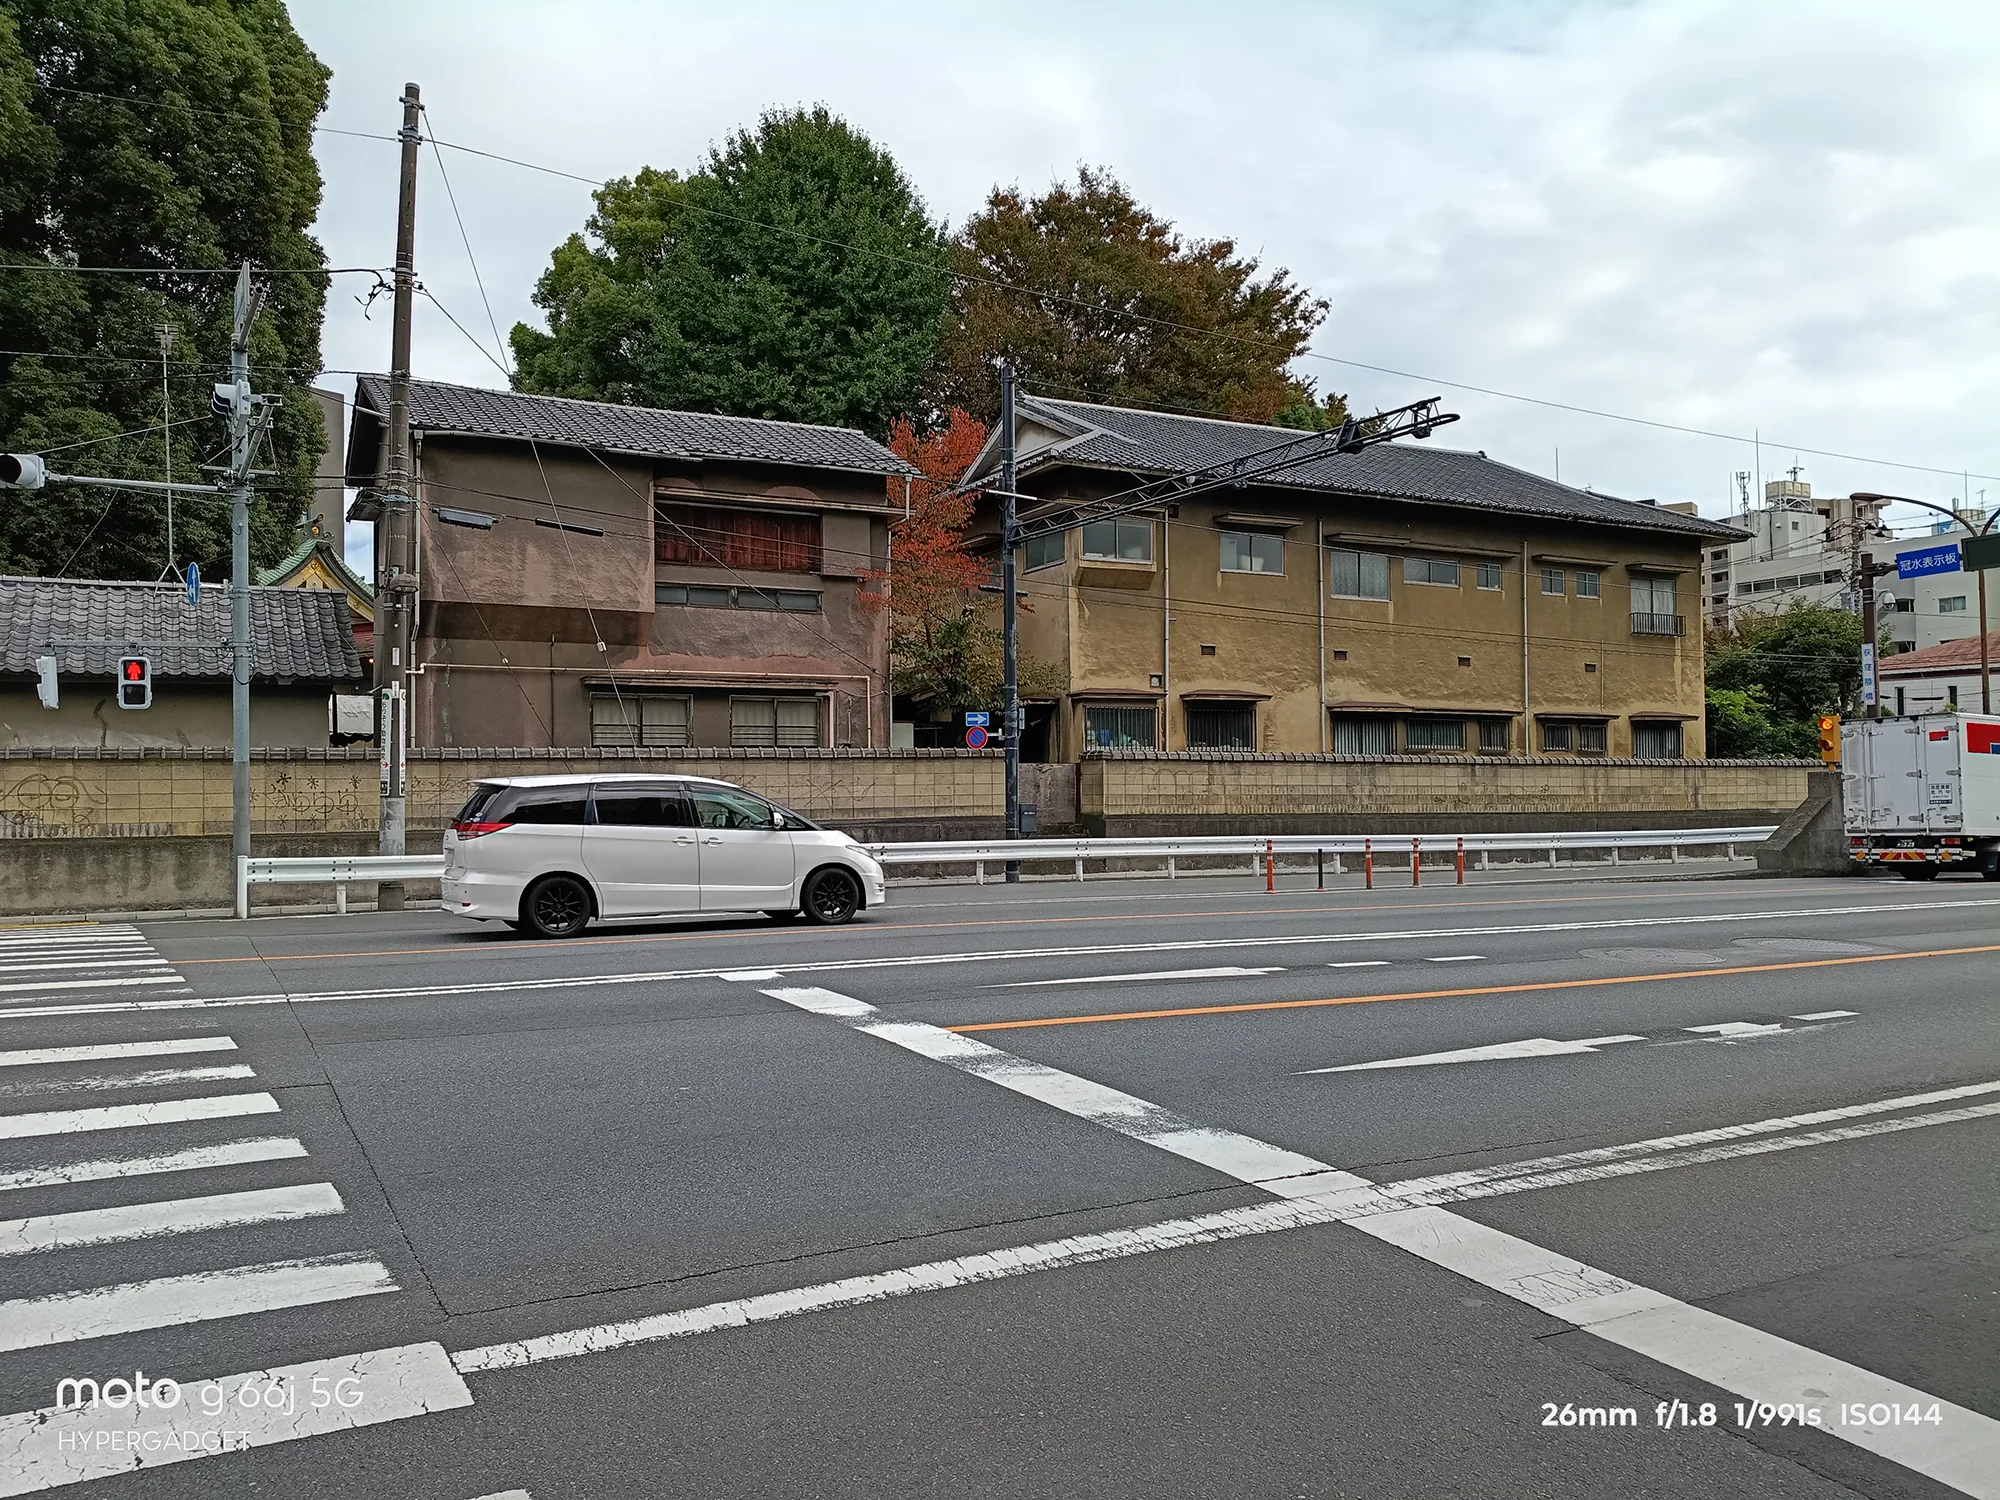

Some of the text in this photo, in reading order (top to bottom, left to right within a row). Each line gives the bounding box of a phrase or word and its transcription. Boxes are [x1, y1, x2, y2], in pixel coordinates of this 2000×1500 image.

[1899, 552, 1957, 572] 冠水表示板
